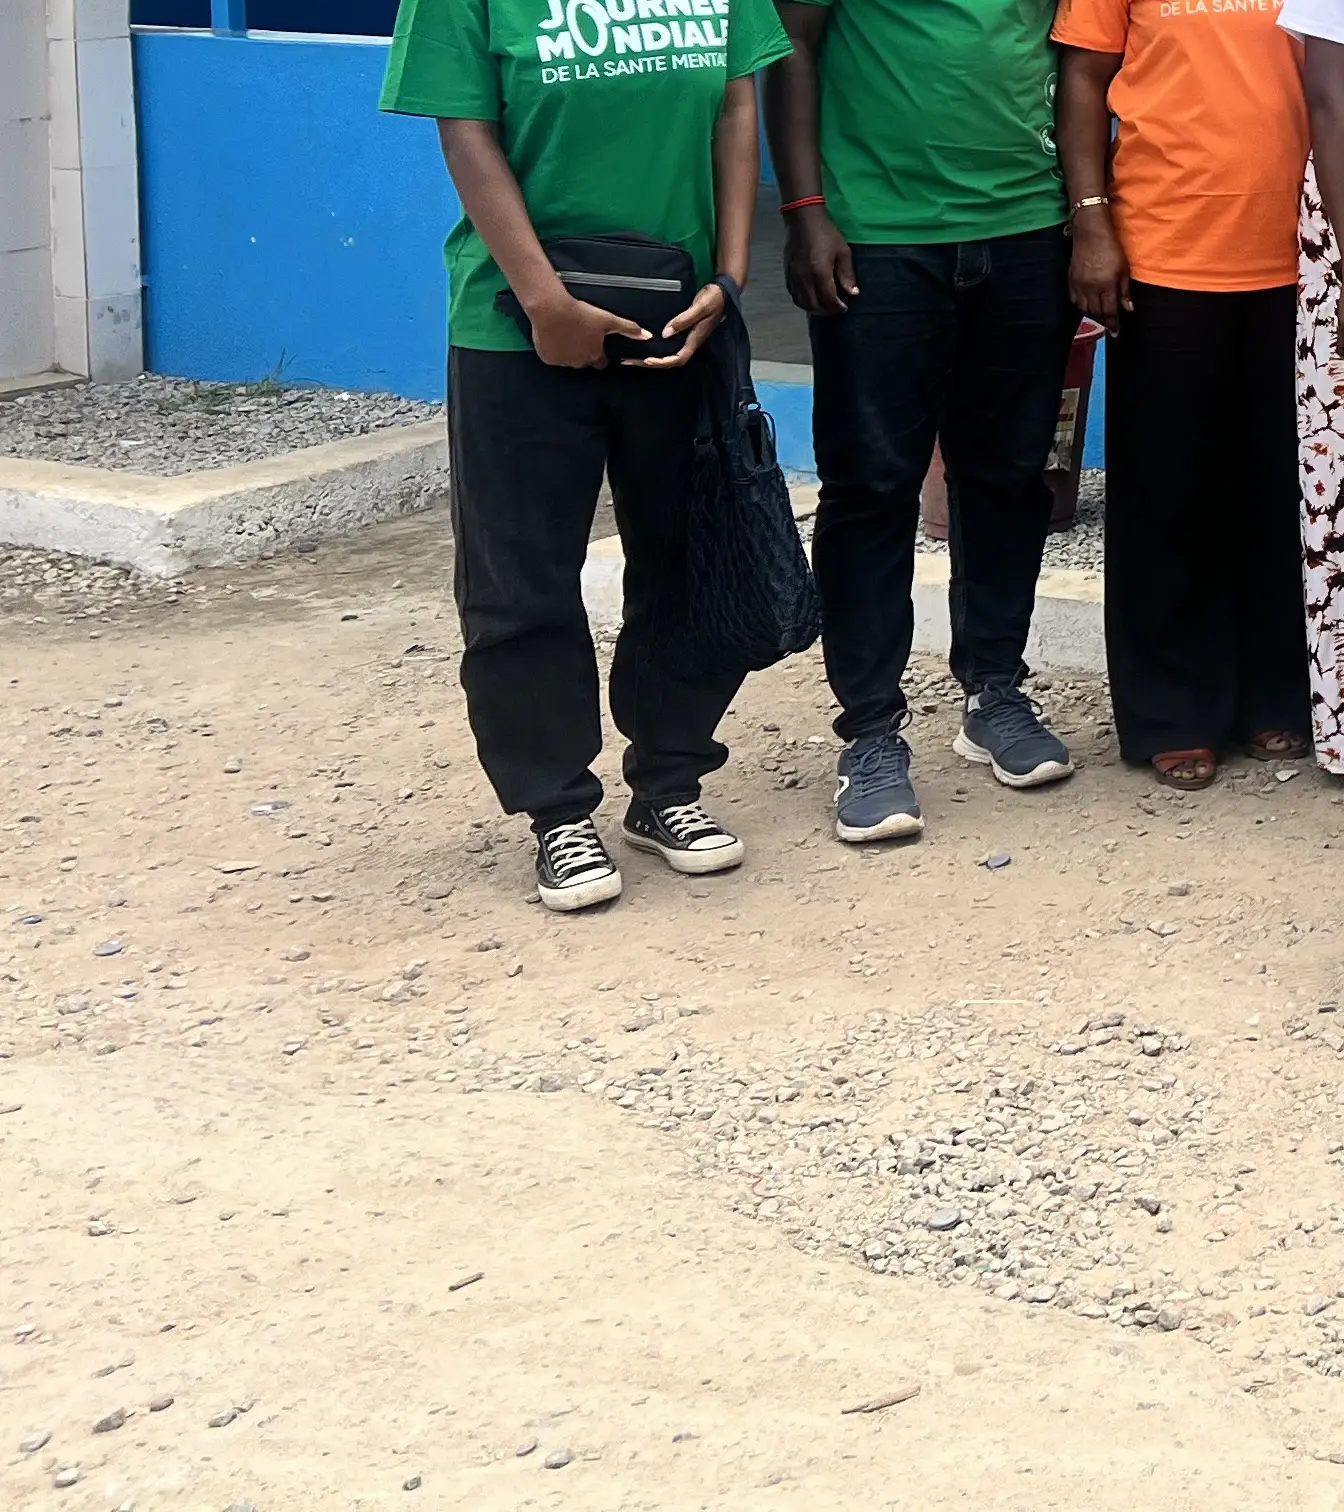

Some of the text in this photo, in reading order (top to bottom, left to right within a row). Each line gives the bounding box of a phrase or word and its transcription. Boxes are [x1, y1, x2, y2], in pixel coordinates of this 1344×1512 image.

[1160, 1, 1181, 18] DE
[1185, 0, 1208, 14] LA
[541, 66, 571, 85] DE
[575, 63, 600, 80] LA
[603, 56, 667, 77] SANTE
